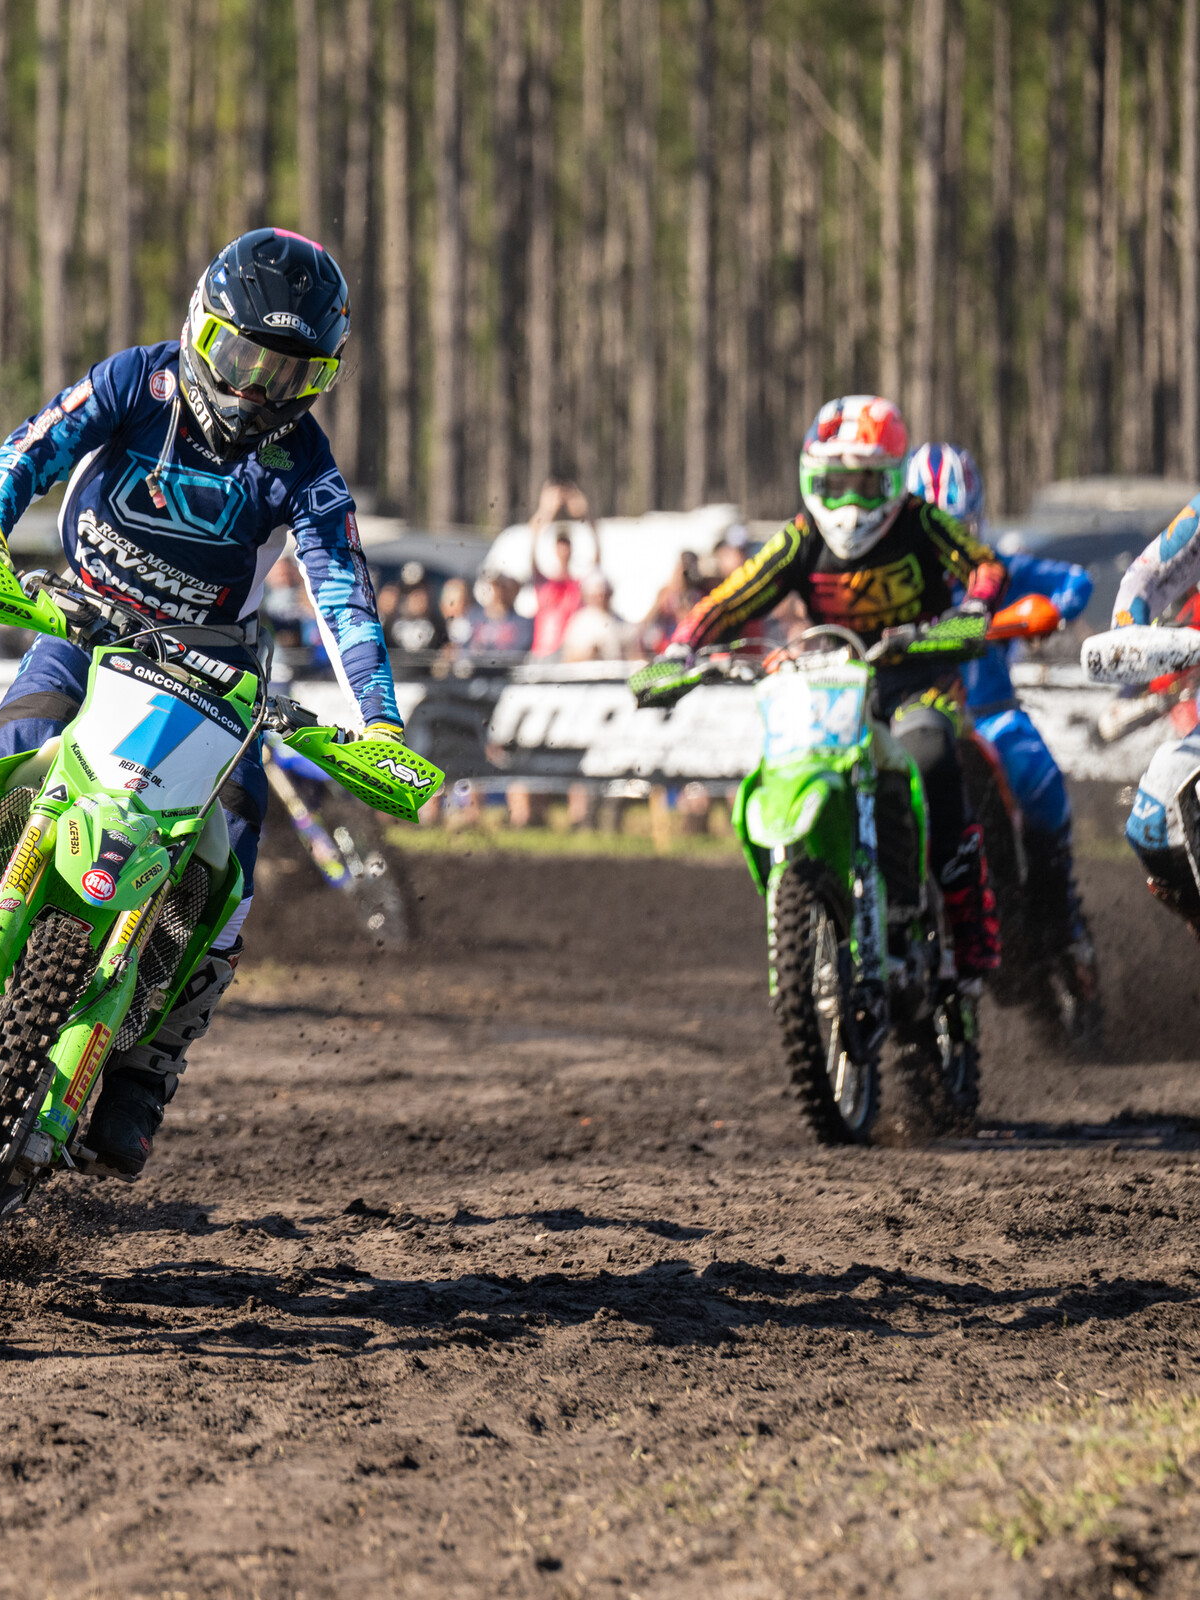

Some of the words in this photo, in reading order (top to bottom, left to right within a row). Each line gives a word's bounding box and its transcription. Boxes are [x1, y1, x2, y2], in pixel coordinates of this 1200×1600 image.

[271, 313, 312, 337] SHOEI
[186, 434, 225, 466] TUSK
[97, 521, 143, 556] ROCKY
[142, 552, 223, 593] MOUNTAIN
[74, 538, 210, 625] Kawasaki
[133, 665, 242, 735] GNCCRACING.COM
[109, 693, 207, 773] 1
[70, 742, 98, 782] Kawasaki
[118, 759, 136, 772] RED
[134, 764, 153, 780] LINE
[150, 774, 164, 788] OIL
[375, 758, 431, 788] ASV
[161, 806, 200, 819] Kawasaki
[88, 874, 115, 896] RM
[63, 1022, 111, 1111] PIRELLI
[46, 1106, 73, 1132] SK
